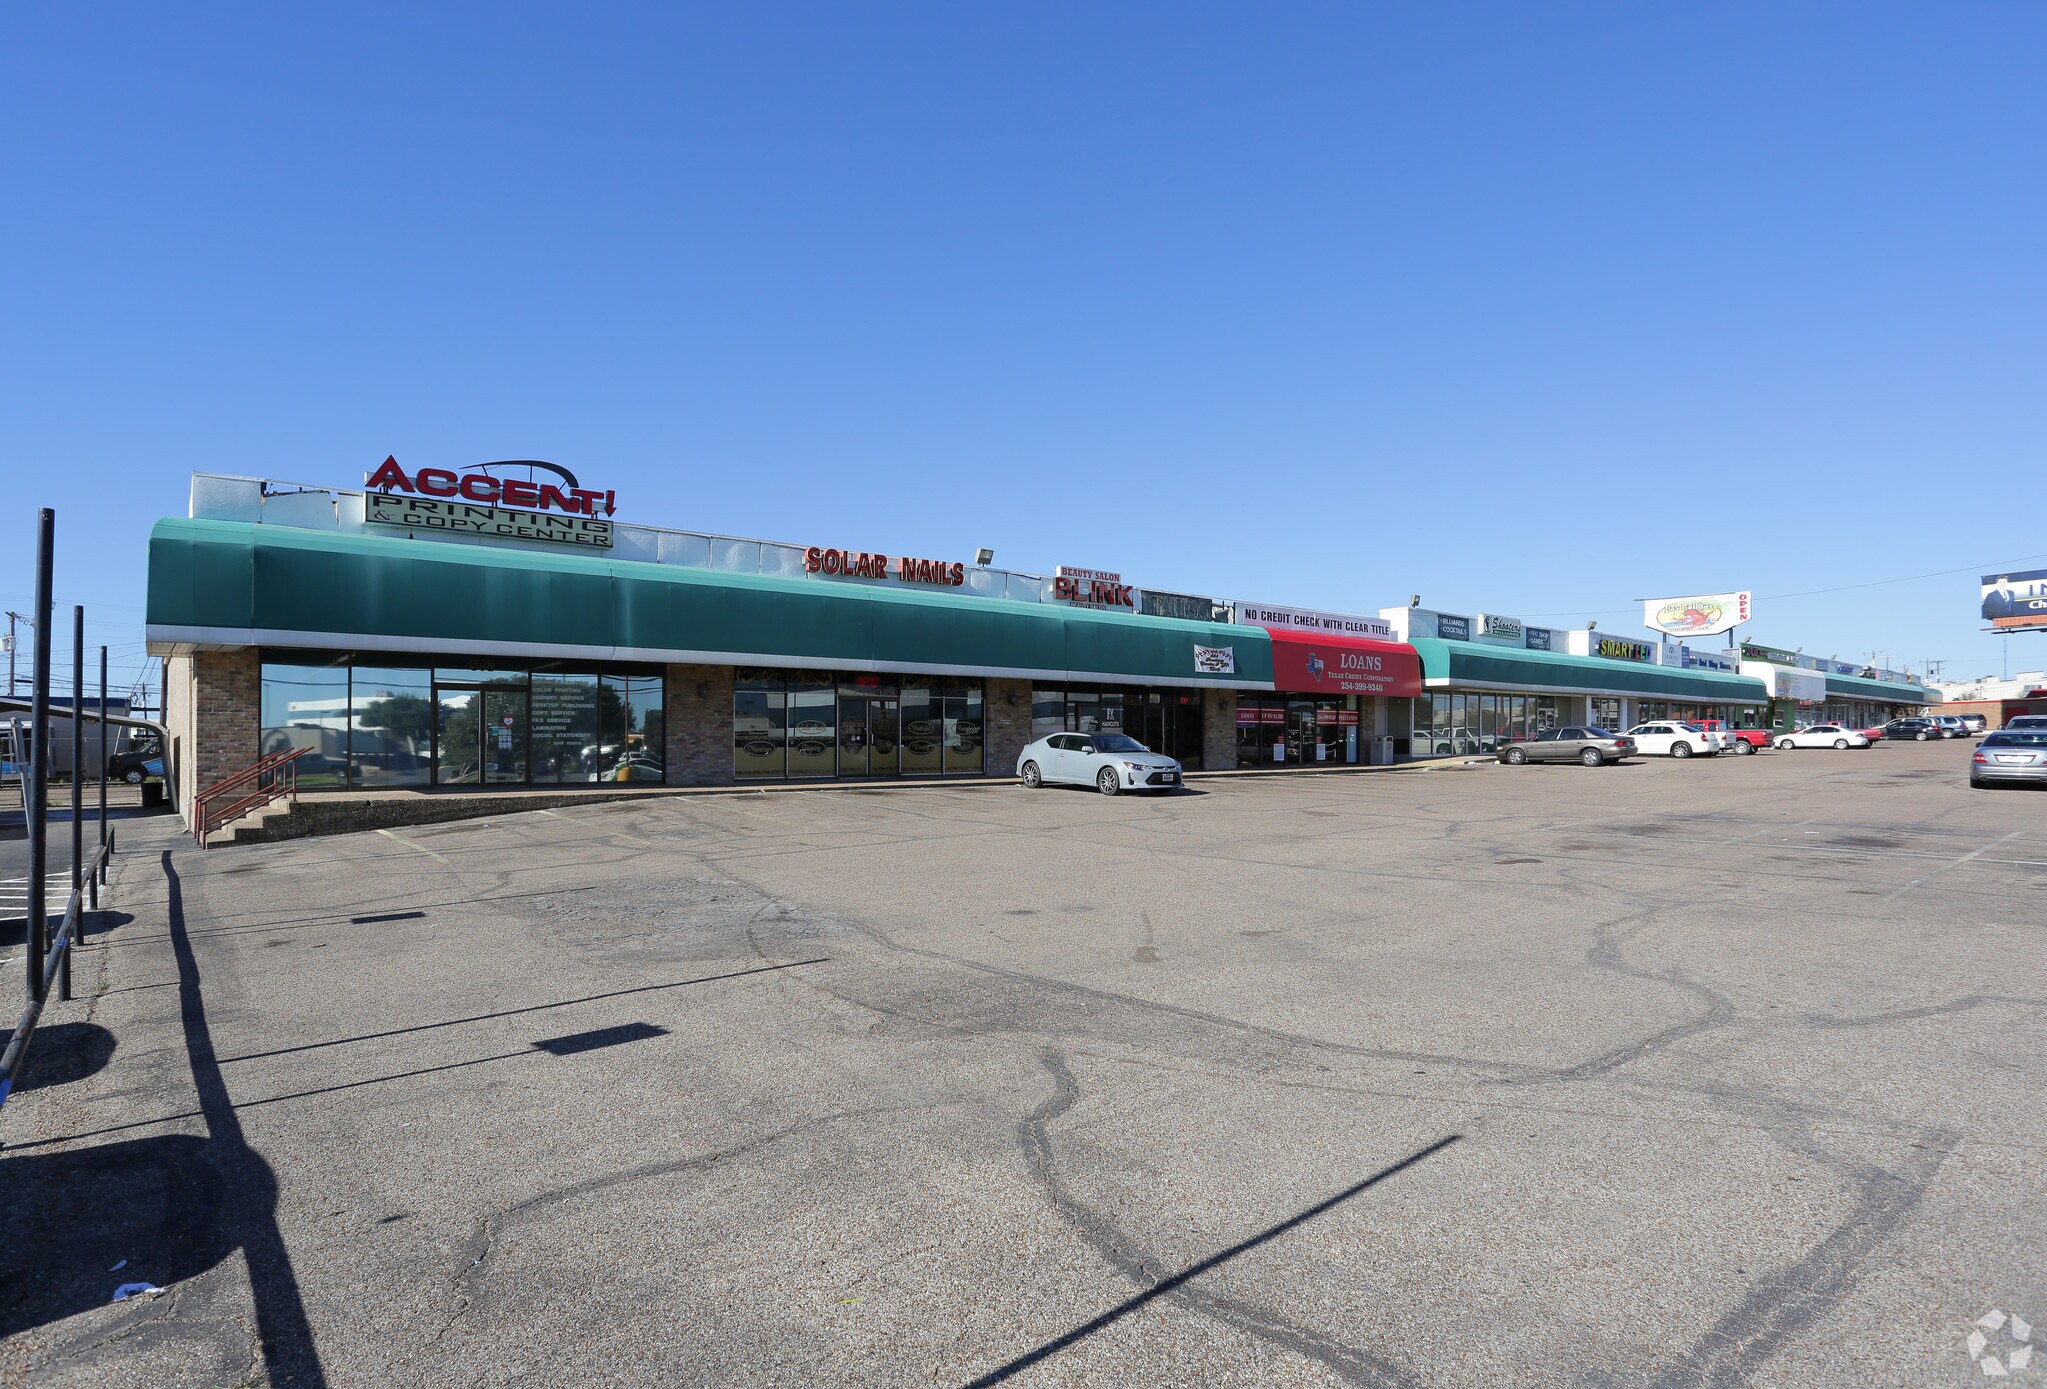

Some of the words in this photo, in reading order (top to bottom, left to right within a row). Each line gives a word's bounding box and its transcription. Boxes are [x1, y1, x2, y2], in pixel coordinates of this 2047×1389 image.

[373, 495, 609, 533] PRINTING
[373, 510, 395, 522] &
[403, 513, 488, 532] COPY
[497, 523, 609, 545] CENTER
[804, 546, 889, 580] SOLAR
[899, 557, 965, 587] NAILS
[1062, 567, 1093, 580] BEAUTY
[1095, 571, 1121, 583] SALON
[1054, 576, 1135, 608] BLINK
[1739, 594, 1748, 620] OPEN
[1245, 608, 1257, 620] NO
[1261, 610, 1291, 624] CREDIT
[1294, 614, 1320, 628] CHECK
[1323, 618, 1343, 630] WITH
[1345, 621, 1369, 633] CLEAR
[1371, 624, 1390, 636] TITLE
[1442, 618, 1465, 627] BILLIARDS
[1492, 617, 1521, 633] Shooters
[1601, 640, 1633, 658] SMART
[1634, 644, 1652, 660] LED
[1340, 653, 1382, 671] LOANS
[1340, 681, 1383, 692] 254-399-9240
